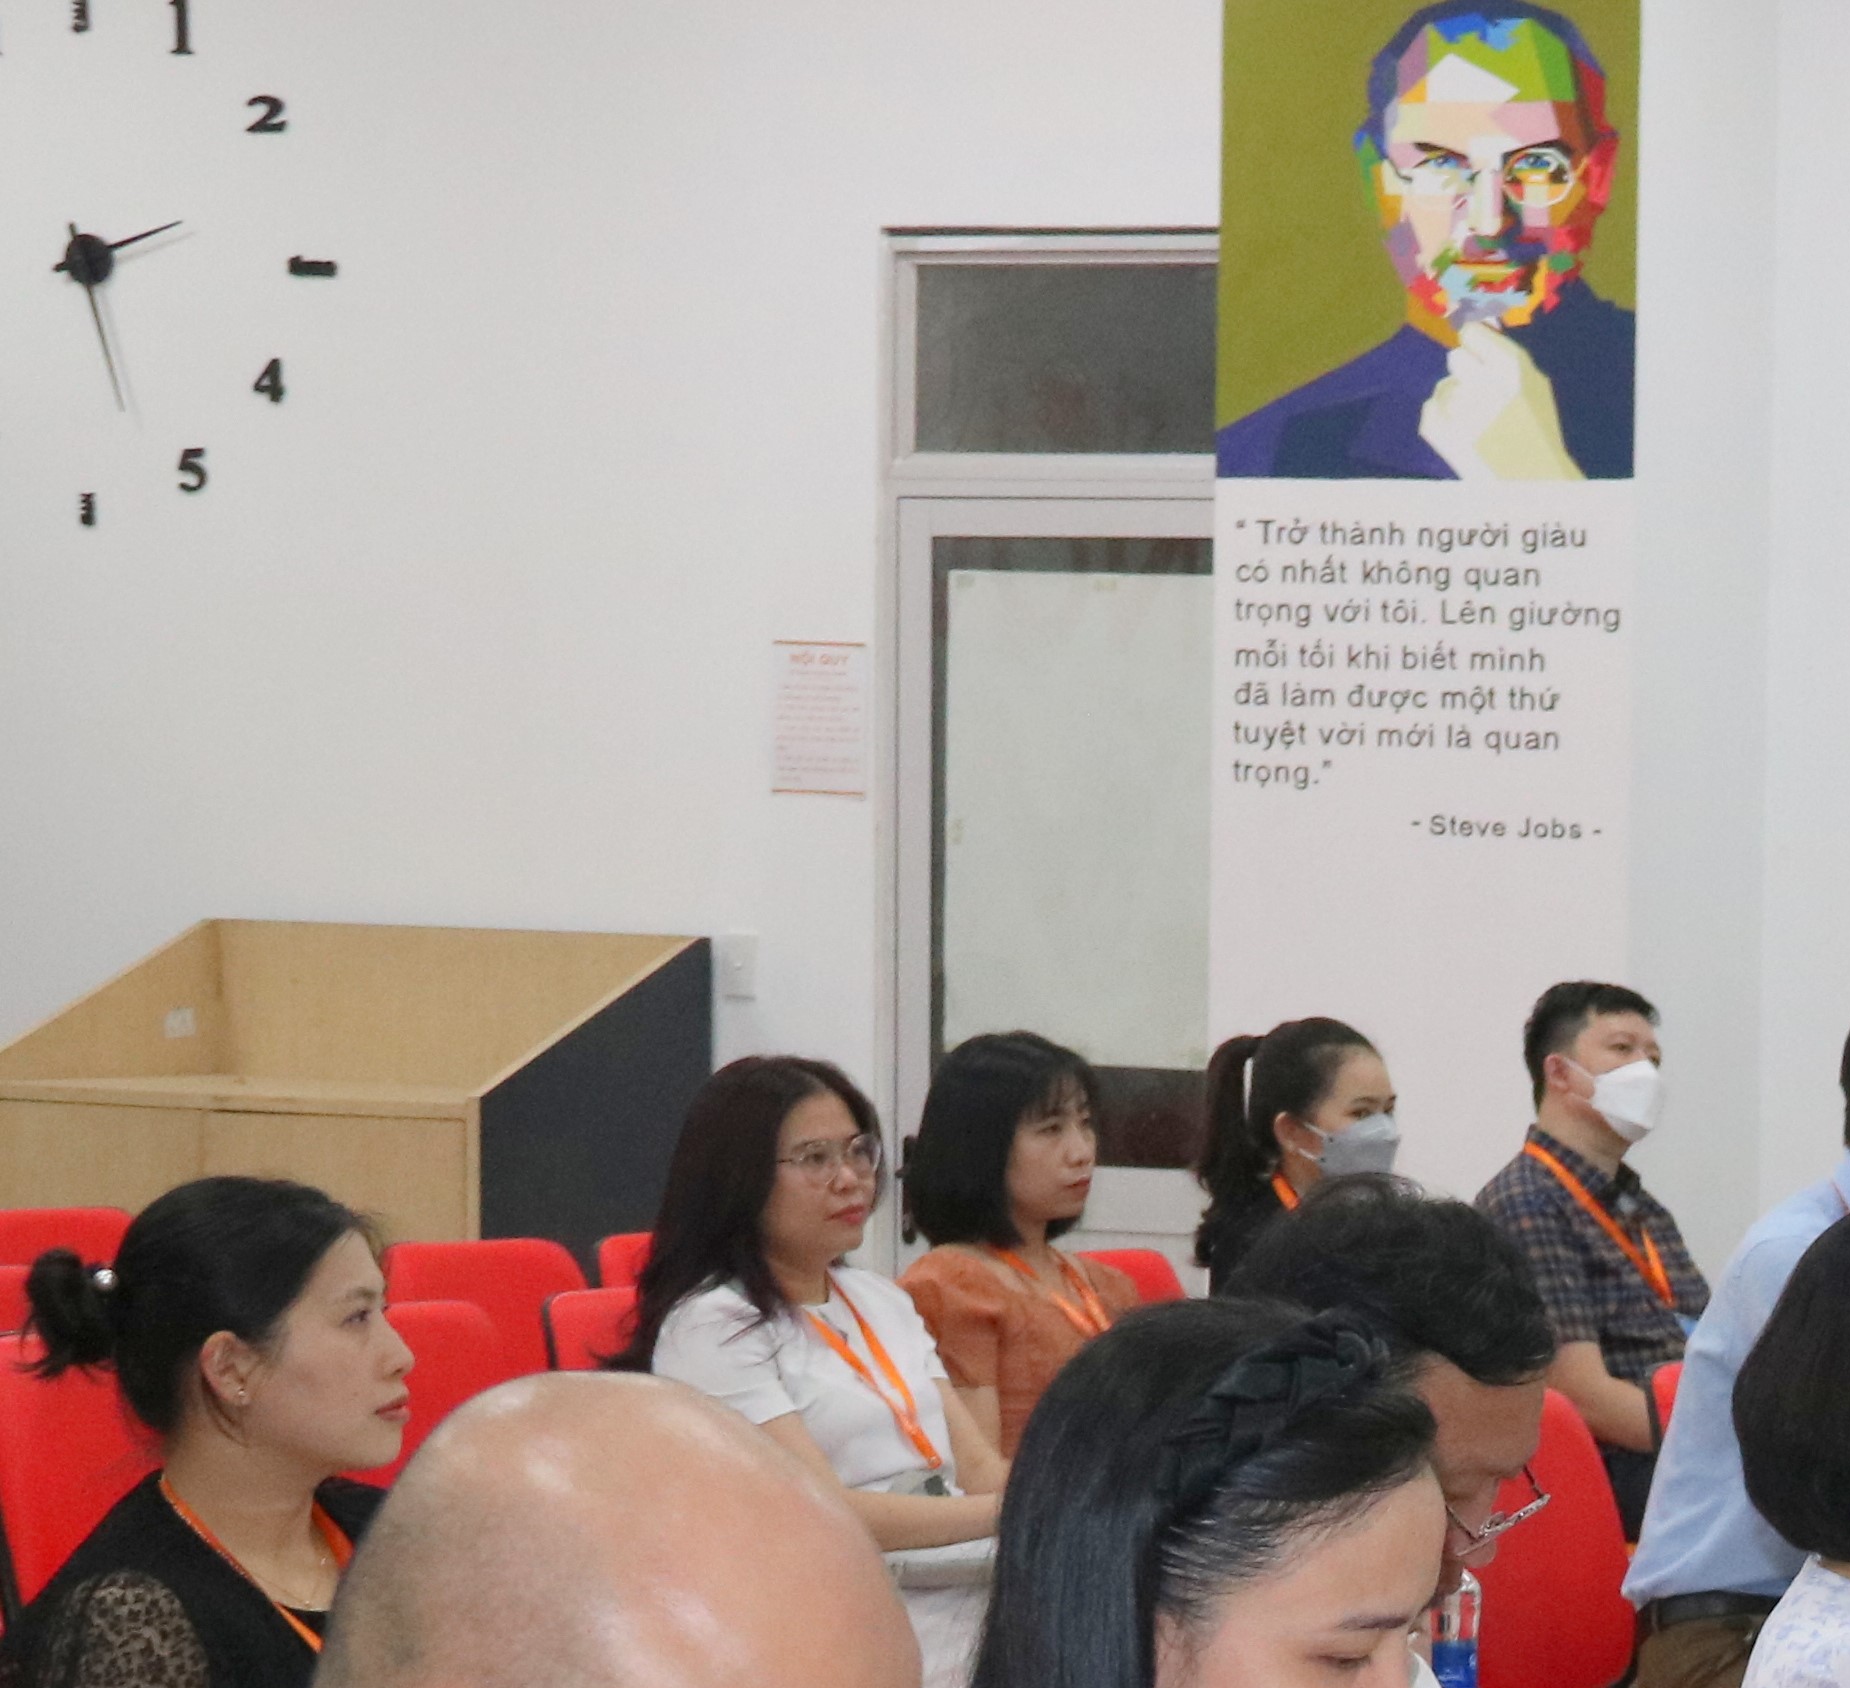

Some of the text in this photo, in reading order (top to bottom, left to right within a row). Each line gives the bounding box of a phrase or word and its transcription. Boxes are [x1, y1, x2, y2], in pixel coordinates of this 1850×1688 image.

[245, 95, 287, 132] 2
[253, 357, 285, 403] 4
[178, 447, 206, 492] 5
[1257, 518, 1309, 547] Trở
[1319, 522, 1405, 547] thành
[1418, 522, 1510, 553] người
[1522, 522, 1587, 554] giàu
[1236, 555, 1541, 591] có nhất không quan
[1234, 599, 1621, 633] trọng với tôi. Lên giường
[1234, 638, 1545, 672] mỗi tối khi biết mình
[1234, 683, 1560, 719] đã làm được một thứ
[1233, 721, 1559, 755] tuyệt vời mới là quan
[1233, 759, 1333, 790] trọng.”
[1429, 814, 1507, 838] Steve
[1518, 817, 1582, 840] Jobs
